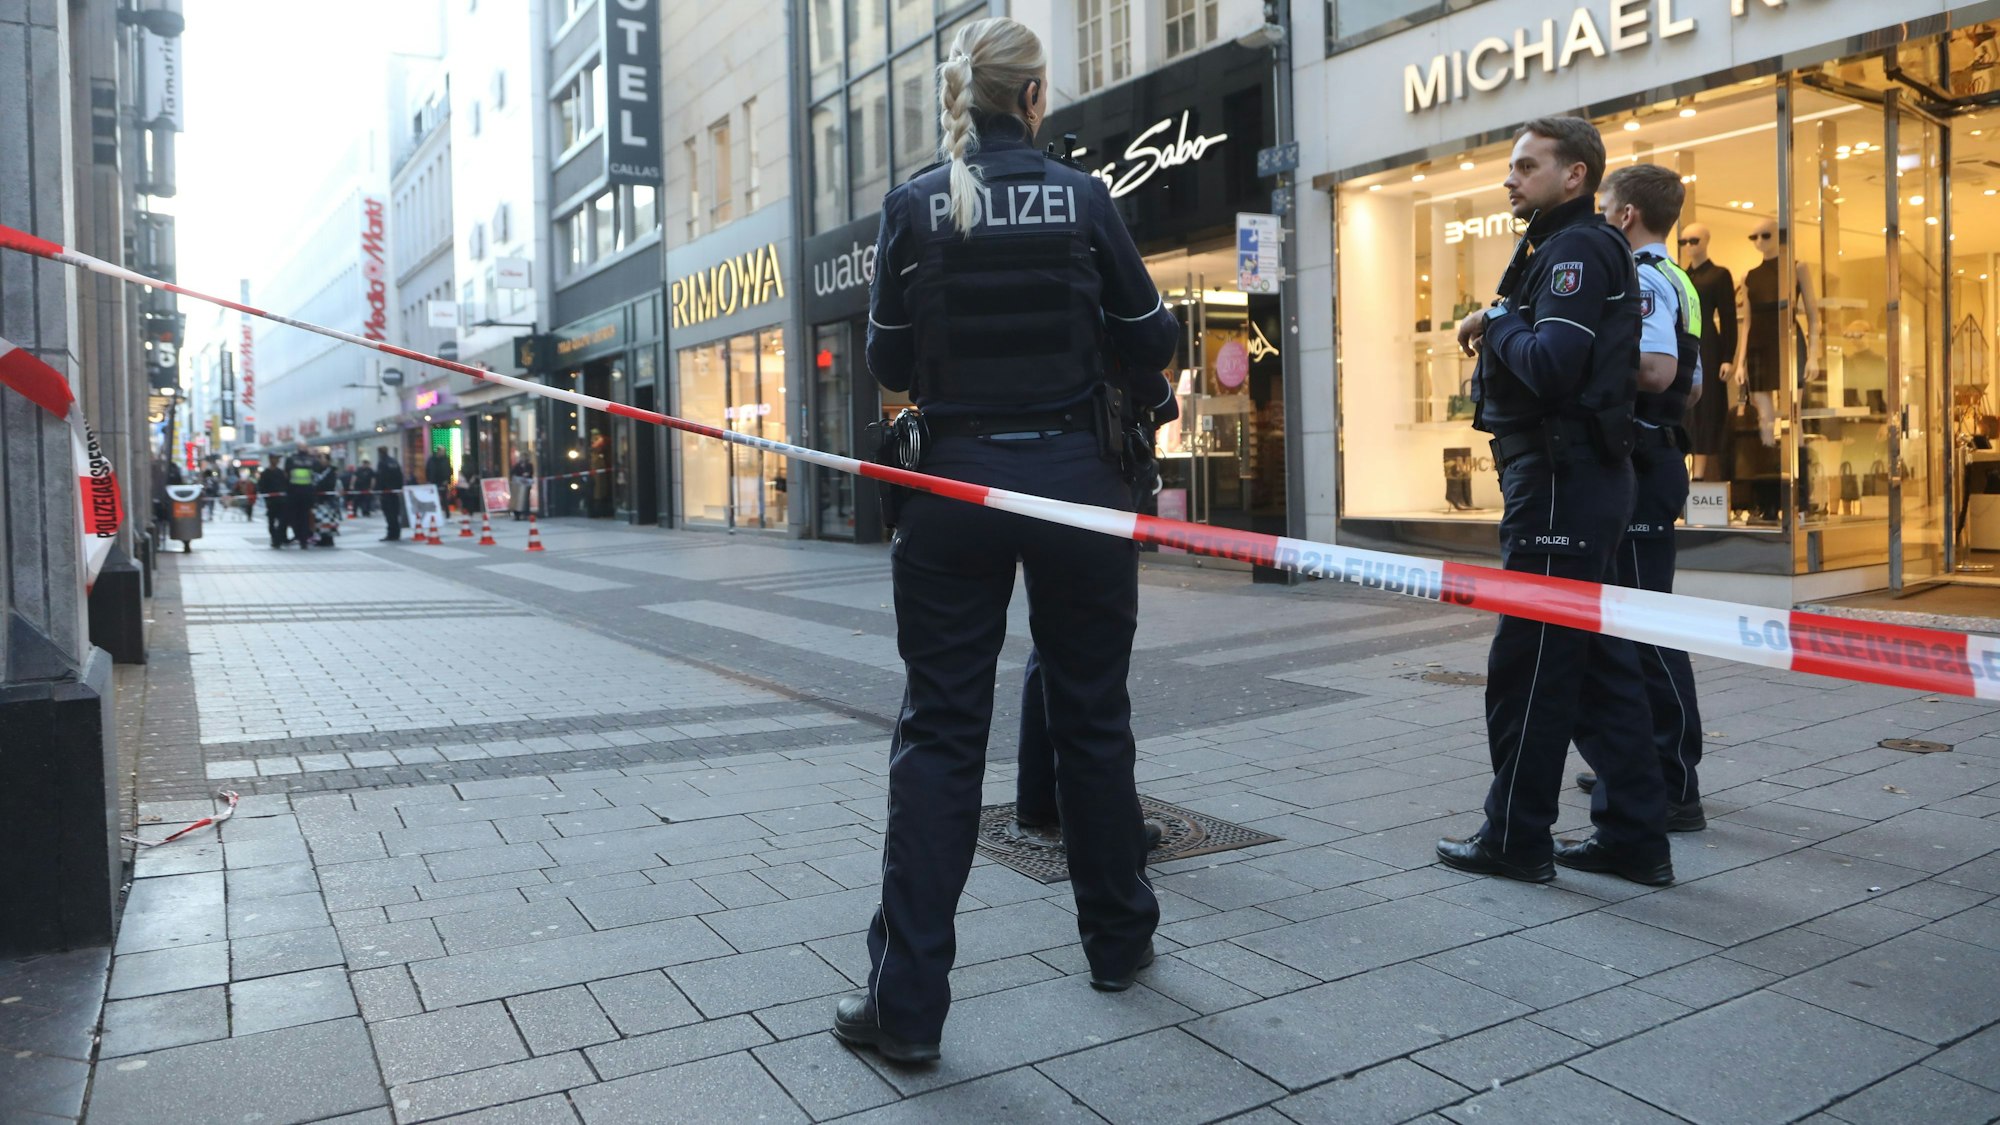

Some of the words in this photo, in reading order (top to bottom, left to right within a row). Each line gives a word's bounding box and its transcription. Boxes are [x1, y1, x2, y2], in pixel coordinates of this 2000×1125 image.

[1404, 0, 1697, 113] MICHAEL
[609, 163, 660, 178] CALLAS
[1110, 109, 1228, 198] Sabo
[672, 242, 784, 330] RIMOWA
[815, 241, 877, 296] wate
[84, 411, 118, 538] POLIZEIABSPER
[1692, 495, 1723, 505] SALE
[1536, 536, 1570, 546] POLIZEI
